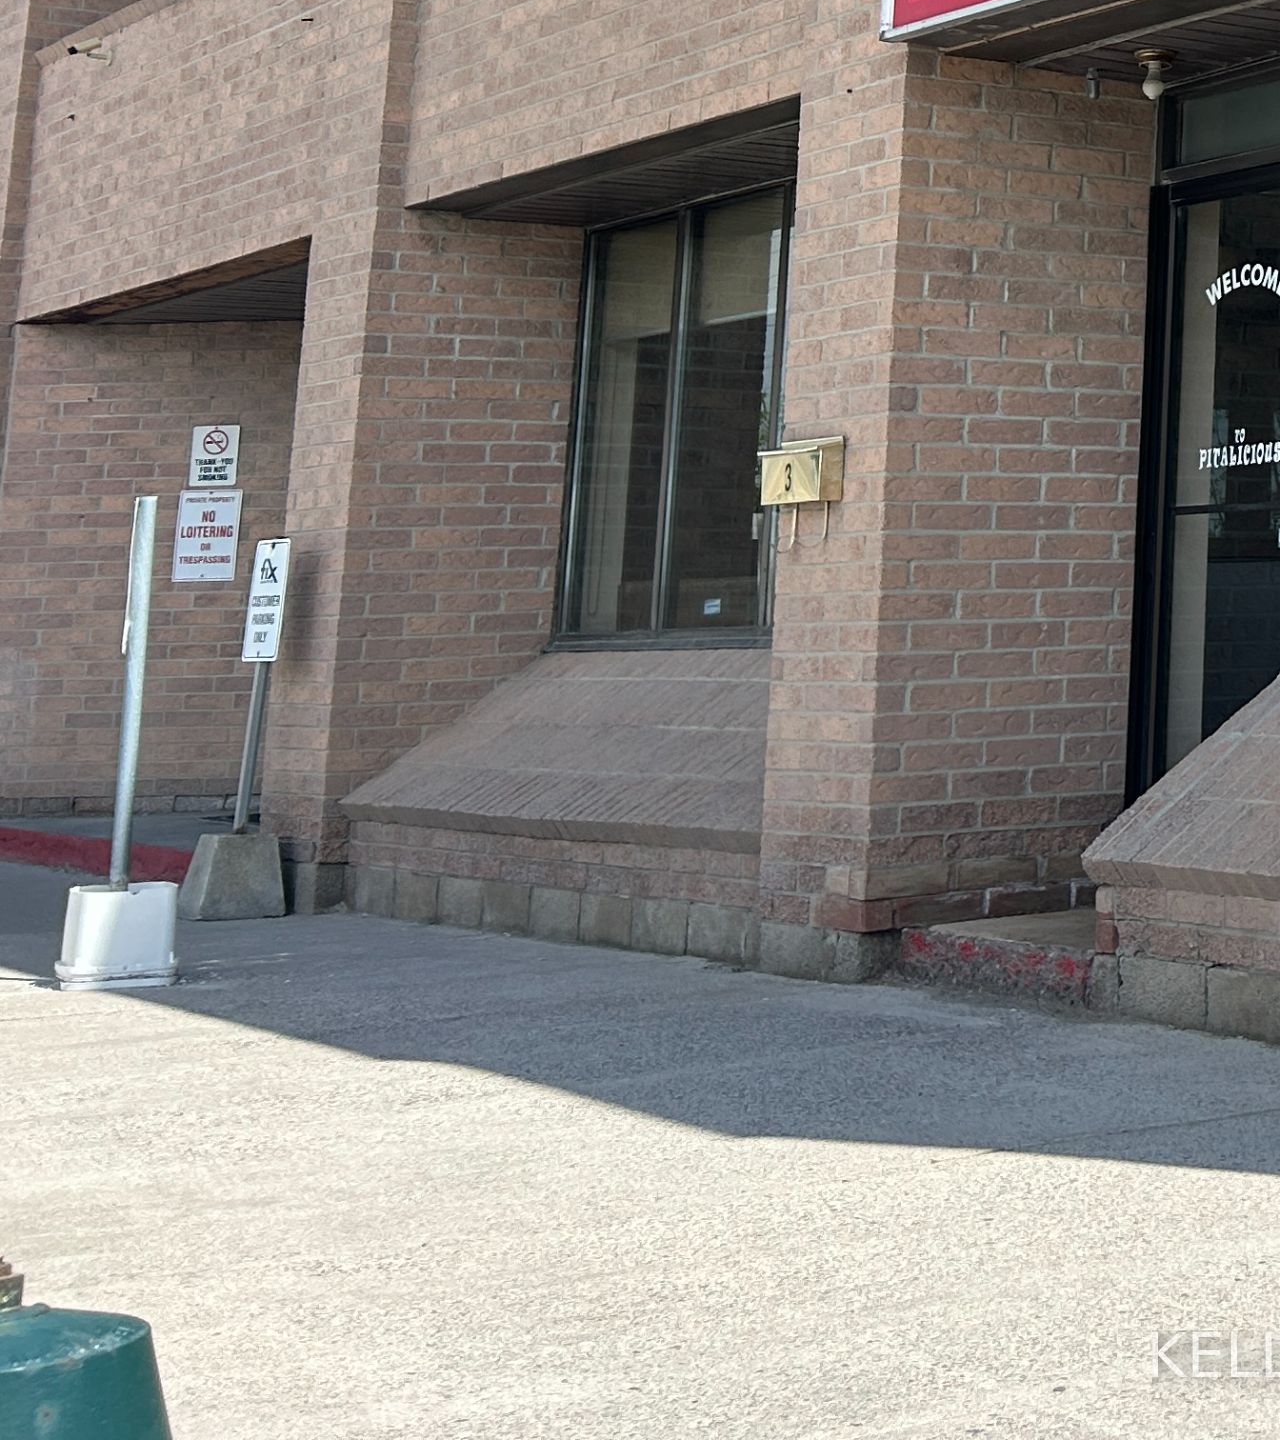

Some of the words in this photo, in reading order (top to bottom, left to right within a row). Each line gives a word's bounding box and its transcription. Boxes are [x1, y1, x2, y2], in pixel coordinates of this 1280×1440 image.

[1234, 428, 1246, 443] TO
[785, 462, 792, 492] 3
[201, 510, 216, 523] NO
[180, 525, 234, 539] LOITERING
[179, 555, 231, 565] TRESPASSING
